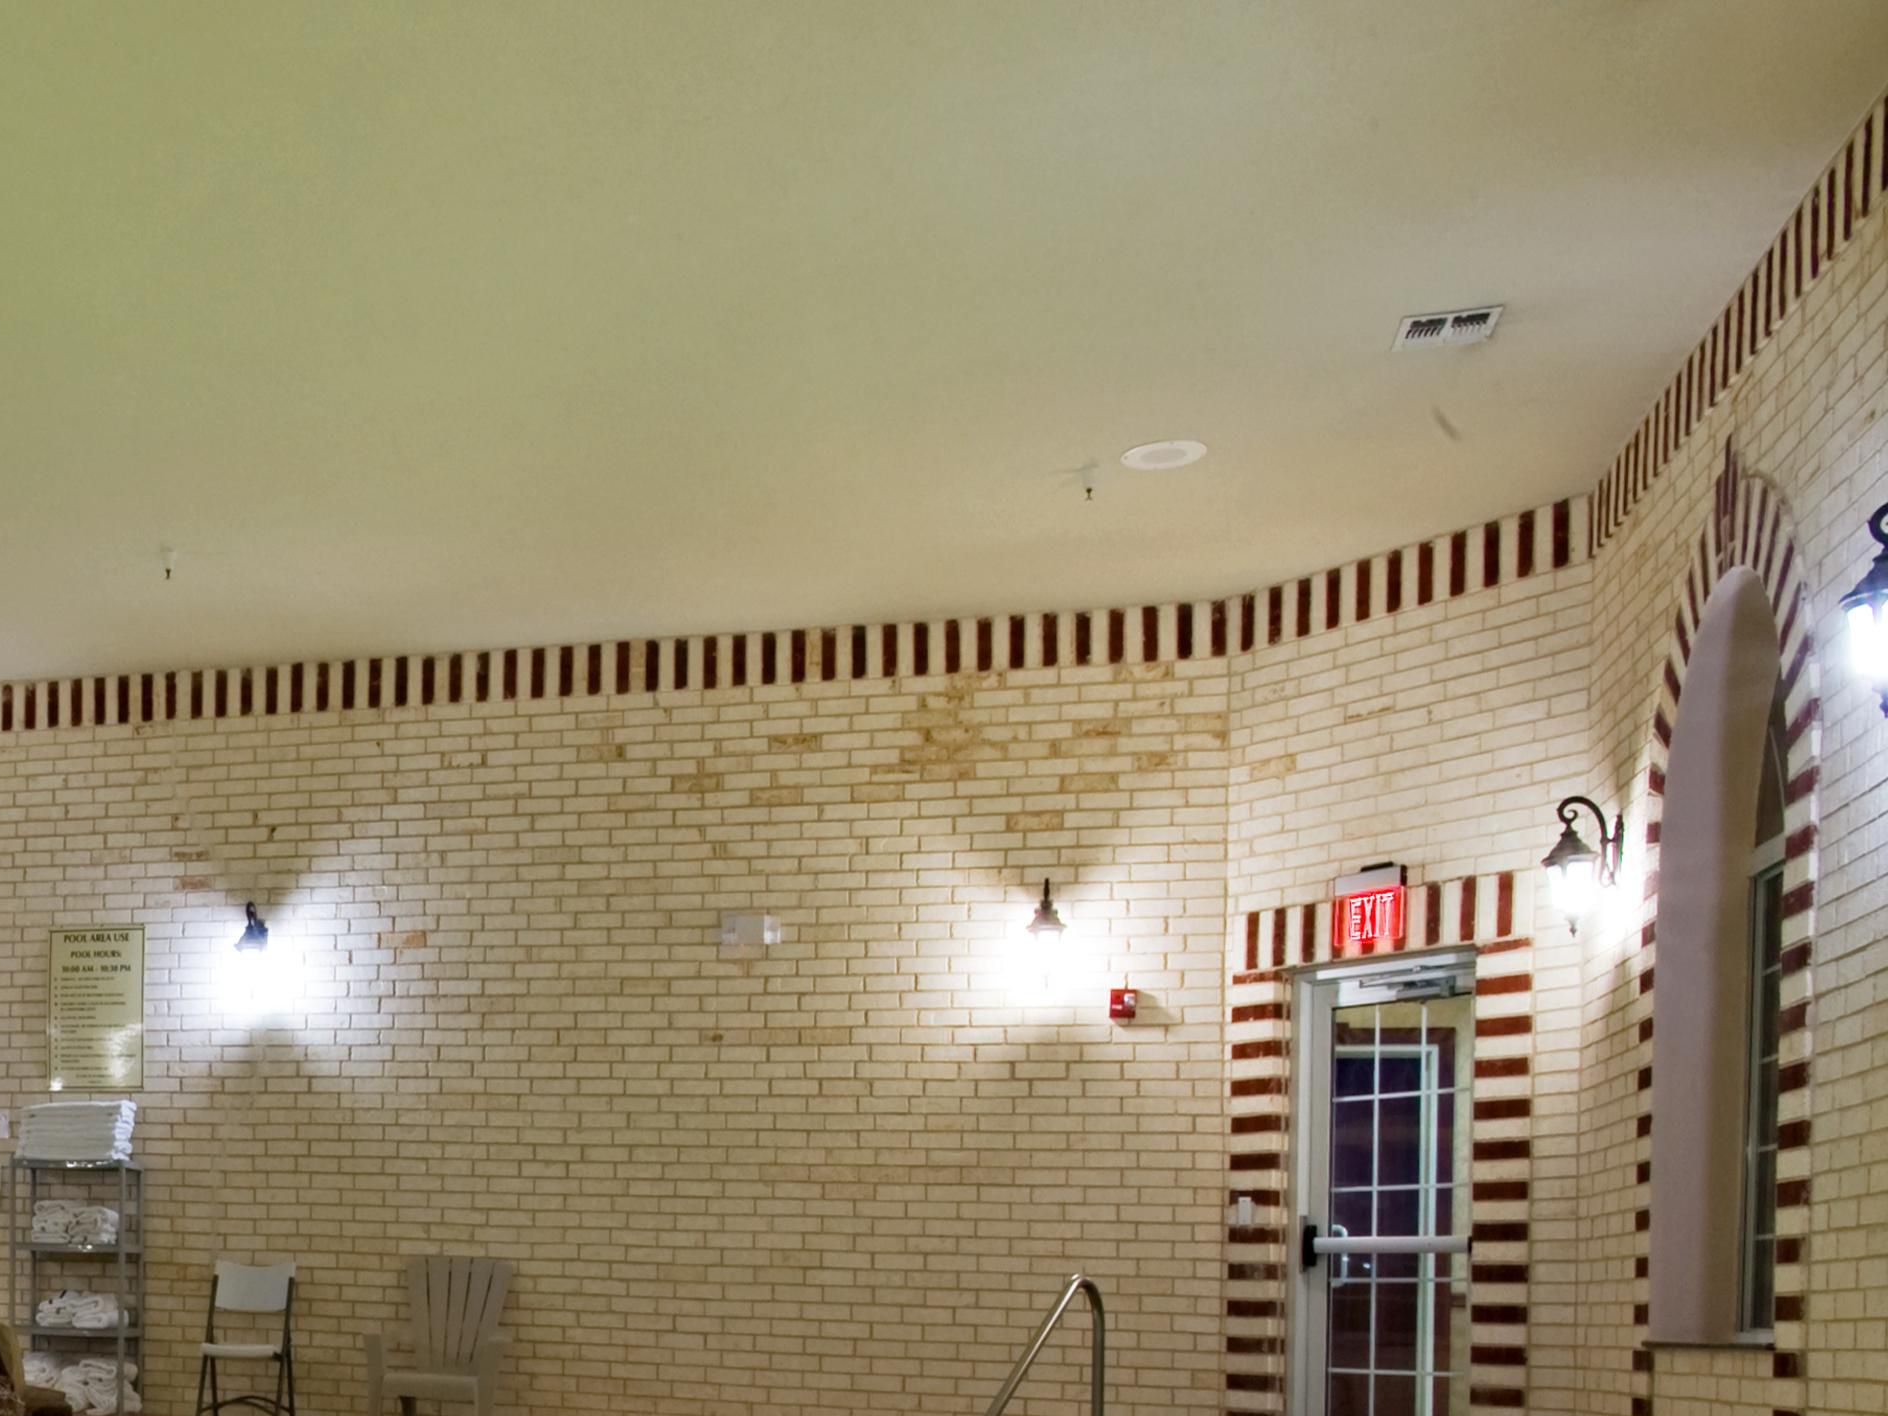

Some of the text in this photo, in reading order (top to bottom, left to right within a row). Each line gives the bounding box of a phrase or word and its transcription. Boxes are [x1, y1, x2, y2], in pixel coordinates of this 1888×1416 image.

[1349, 891, 1395, 941] EXIT
[63, 932, 129, 943] POOL AREA USE
[70, 950, 91, 958] POOL
